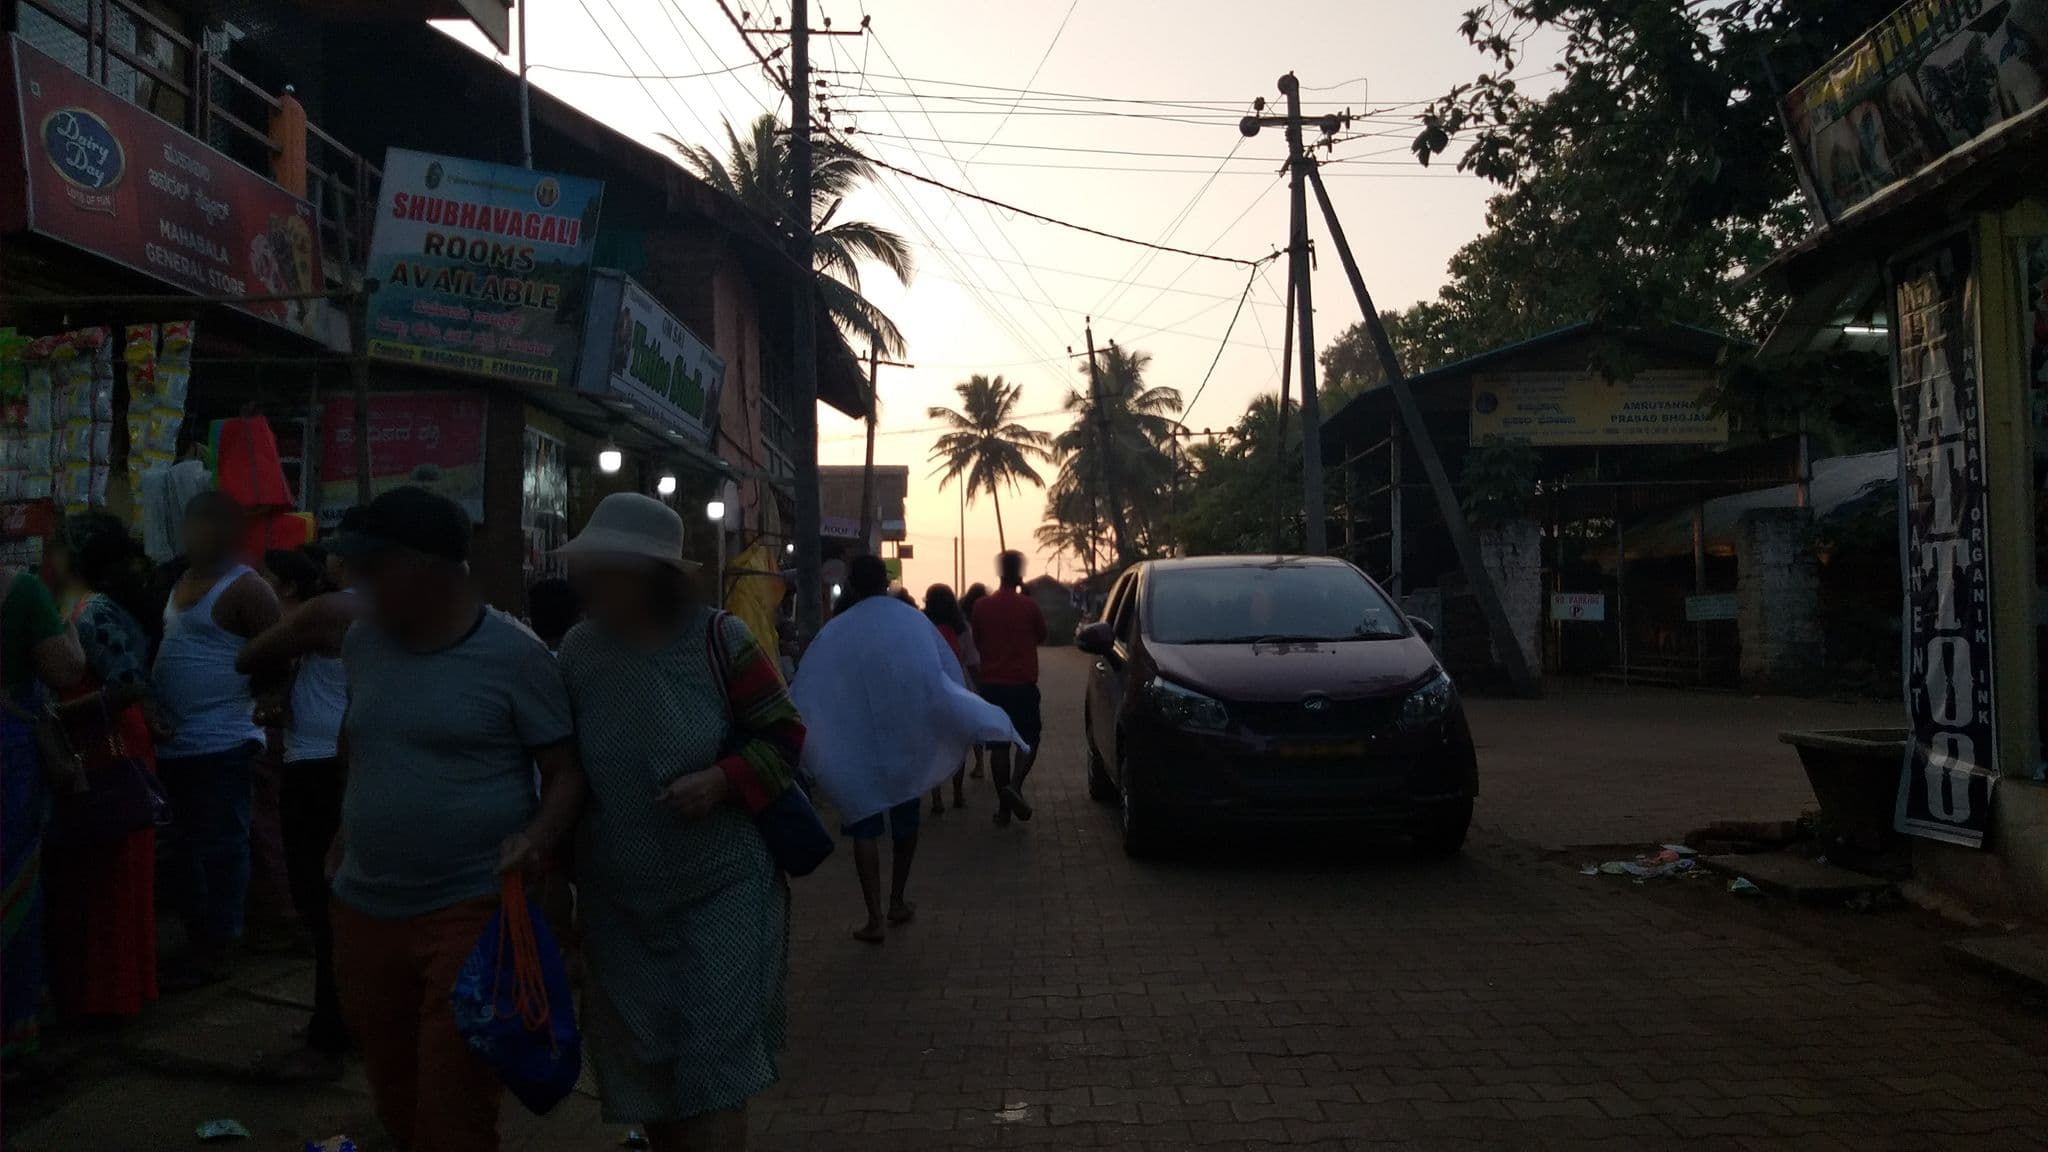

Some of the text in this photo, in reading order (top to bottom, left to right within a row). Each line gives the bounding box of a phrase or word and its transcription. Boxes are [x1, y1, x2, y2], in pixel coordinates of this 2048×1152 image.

[56, 111, 109, 165] Dairy
[65, 141, 105, 188] Day
[159, 217, 230, 265] MAHABALA
[391, 191, 582, 248] SHUBHAVAGALI
[144, 241, 247, 296] GENERAL STORE
[423, 230, 537, 273] ROOMS
[389, 259, 562, 312] AVAILABLE
[629, 319, 672, 398] Tattoo
[1611, 413, 1658, 423] PRASAD
[1978, 668, 1992, 726] INK
